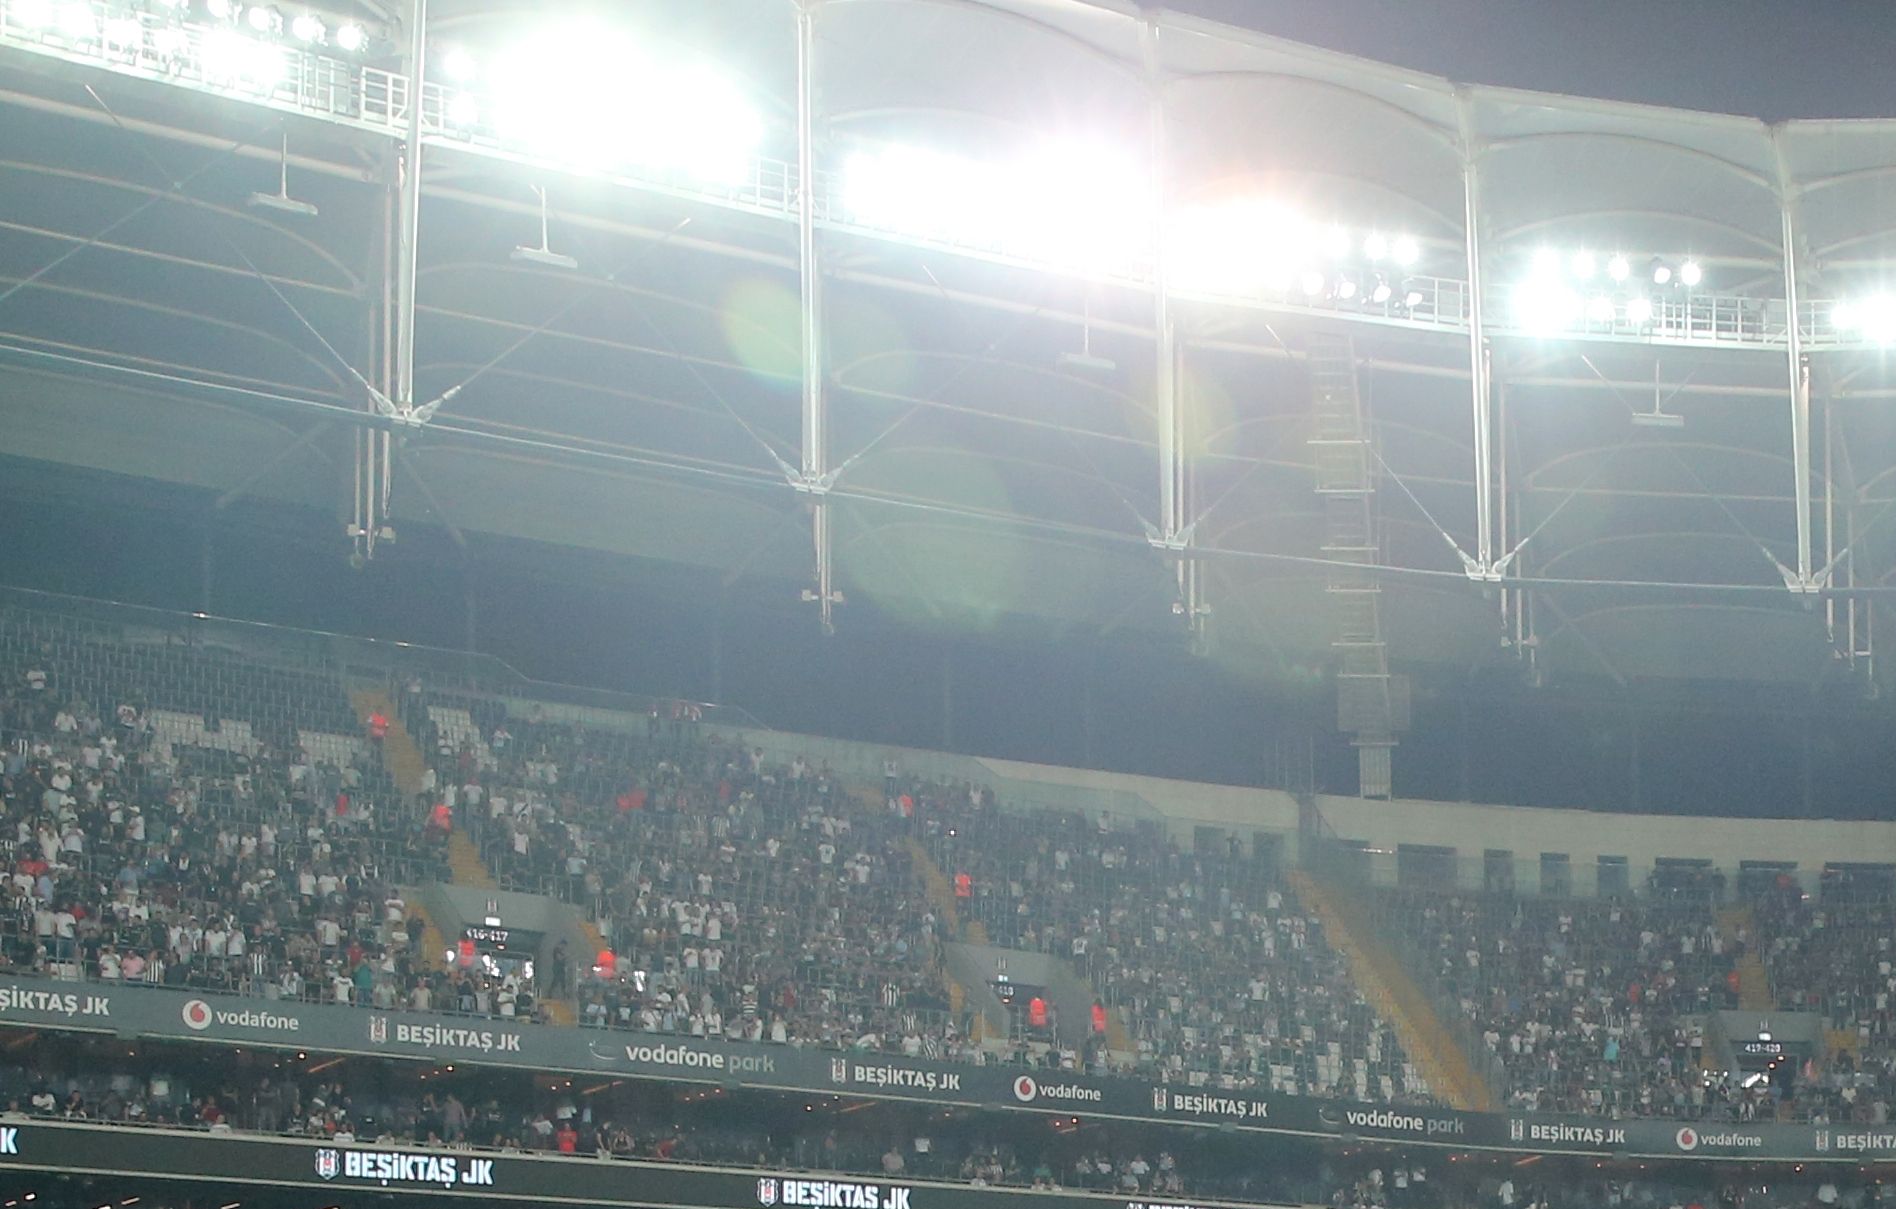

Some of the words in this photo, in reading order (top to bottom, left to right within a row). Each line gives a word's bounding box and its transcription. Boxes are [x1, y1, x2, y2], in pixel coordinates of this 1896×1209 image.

[83, 996, 110, 1016] JK
[217, 1008, 299, 1031] vodafone
[397, 1024, 493, 1053] BEŞİKTAŞ
[497, 1033, 520, 1052] JK
[626, 1045, 724, 1069] vodafone
[729, 1054, 775, 1074] park
[854, 1064, 937, 1092] BEŞİKTAŞ
[939, 1072, 960, 1091] JK
[1039, 1084, 1101, 1102] vodafone
[1173, 1094, 1247, 1118] BEŞİKTAŞ
[1249, 1102, 1267, 1117] JK
[1346, 1110, 1423, 1132] vodafone
[1427, 1117, 1464, 1135] park
[1530, 1122, 1604, 1145] BEŞİKTAŞ
[1606, 1128, 1625, 1143] JK
[1701, 1132, 1762, 1147] vodafone
[345, 1151, 456, 1189] BEŞİKTAŞ
[461, 1159, 494, 1185] JK
